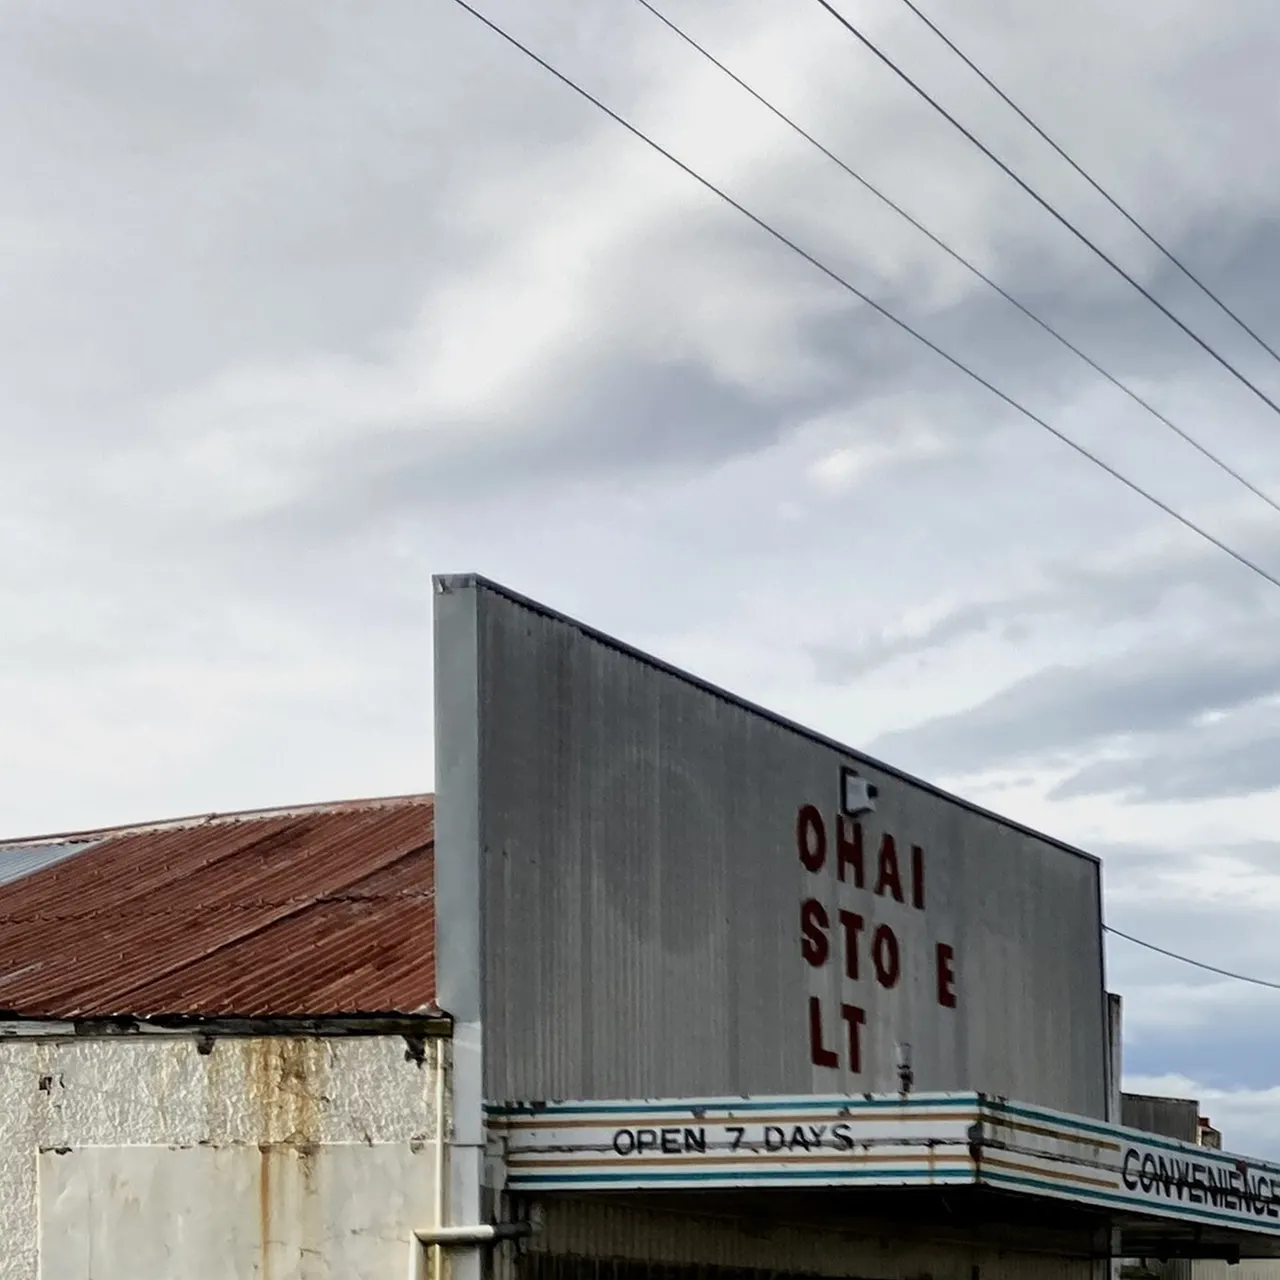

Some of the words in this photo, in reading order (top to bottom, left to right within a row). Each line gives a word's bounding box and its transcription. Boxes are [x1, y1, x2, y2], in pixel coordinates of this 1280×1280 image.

[796, 804, 925, 910] OHAI
[613, 1128, 706, 1155] OPEN
[725, 1128, 745, 1152] 7
[765, 1124, 855, 1154] DAYS
[1122, 1148, 1280, 1216] CONVENIENCE
